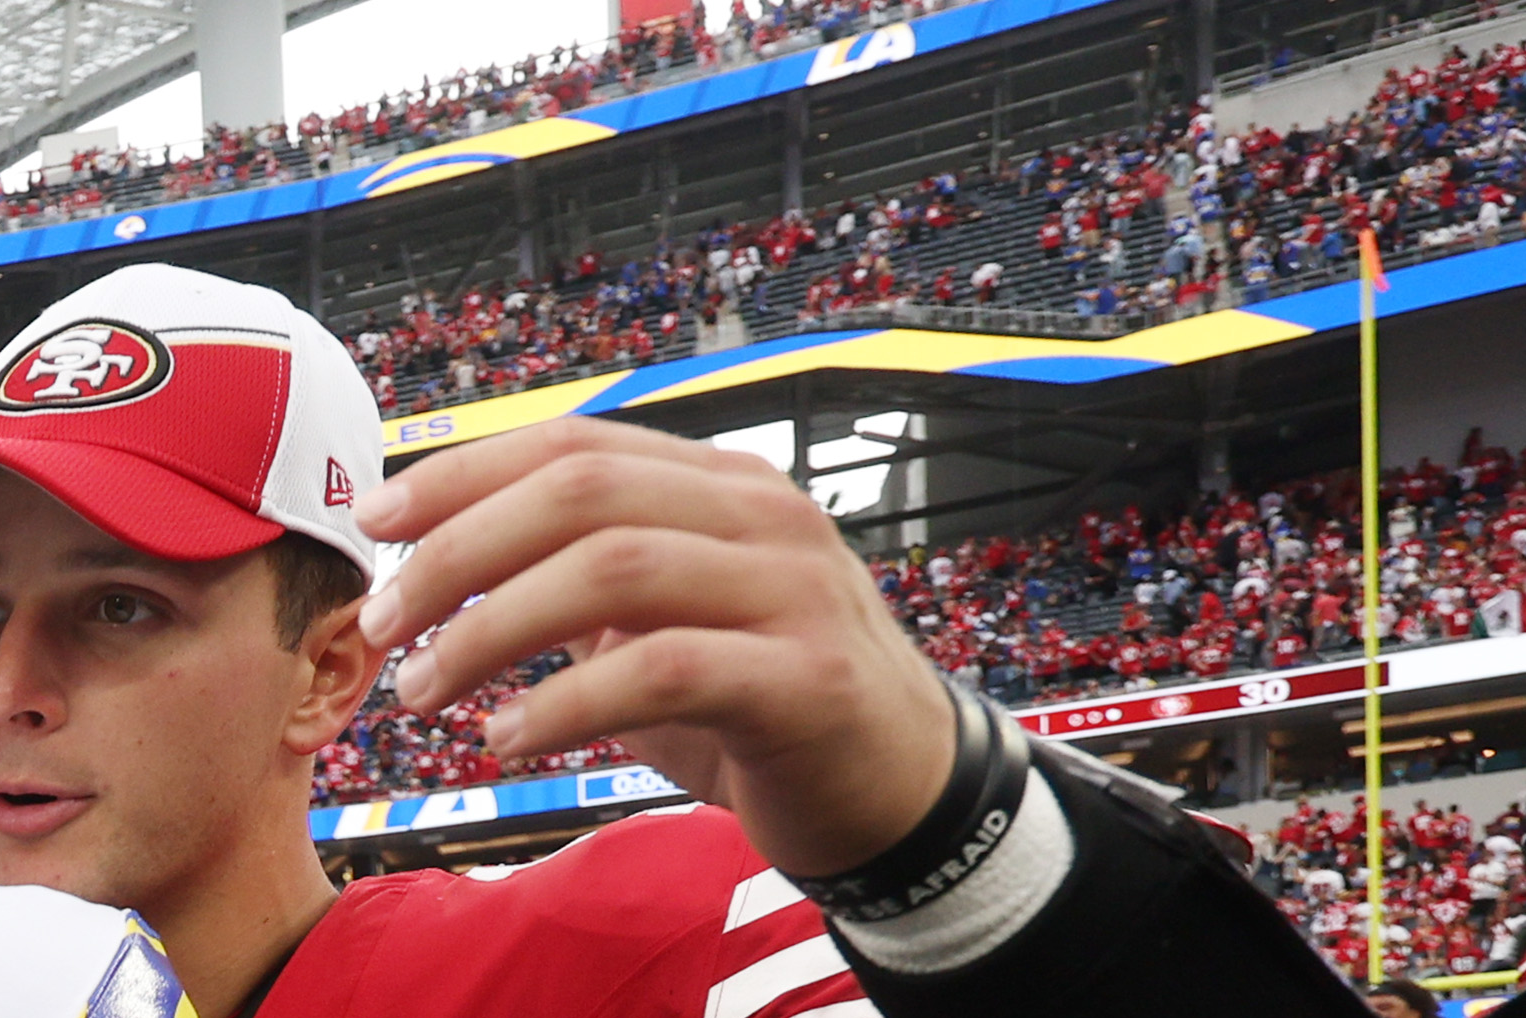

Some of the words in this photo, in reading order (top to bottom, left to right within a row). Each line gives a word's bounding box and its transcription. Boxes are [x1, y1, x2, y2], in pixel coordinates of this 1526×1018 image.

[804, 20, 916, 87] LA
[383, 416, 453, 447] ES
[1238, 678, 1291, 708] 30
[333, 784, 500, 840] LA
[908, 809, 1010, 907] AFRAID
